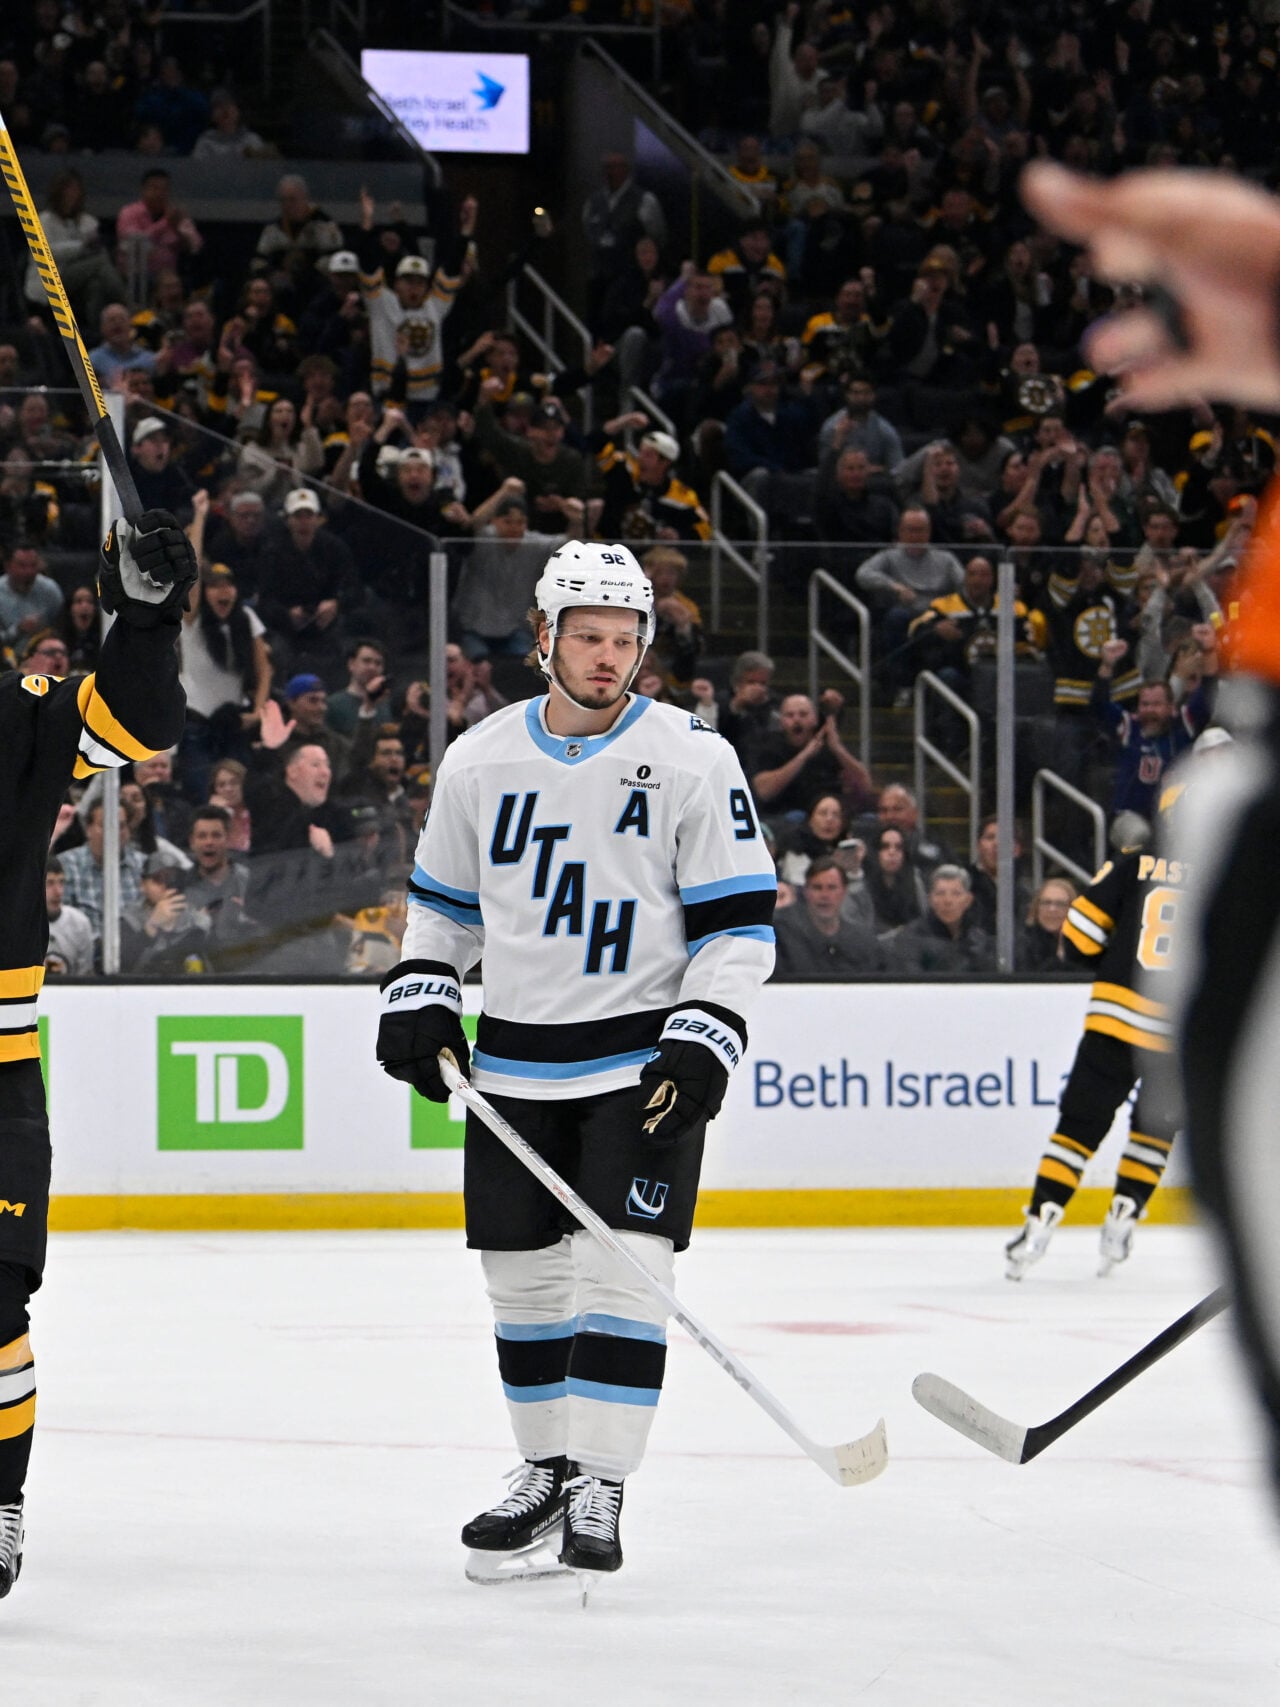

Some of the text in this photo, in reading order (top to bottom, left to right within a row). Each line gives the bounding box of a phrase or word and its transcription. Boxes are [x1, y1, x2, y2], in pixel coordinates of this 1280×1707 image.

[424, 96, 467, 112] Israel
[435, 116, 488, 132] Health
[600, 552, 627, 566] 92
[619, 777, 661, 790] 1Password
[614, 788, 651, 839] A
[729, 787, 758, 841] 9
[488, 790, 639, 976] UTAH
[170, 1041, 290, 1124] TD
[753, 1060, 868, 1109] Beth
[885, 1057, 1017, 1108] Israel
